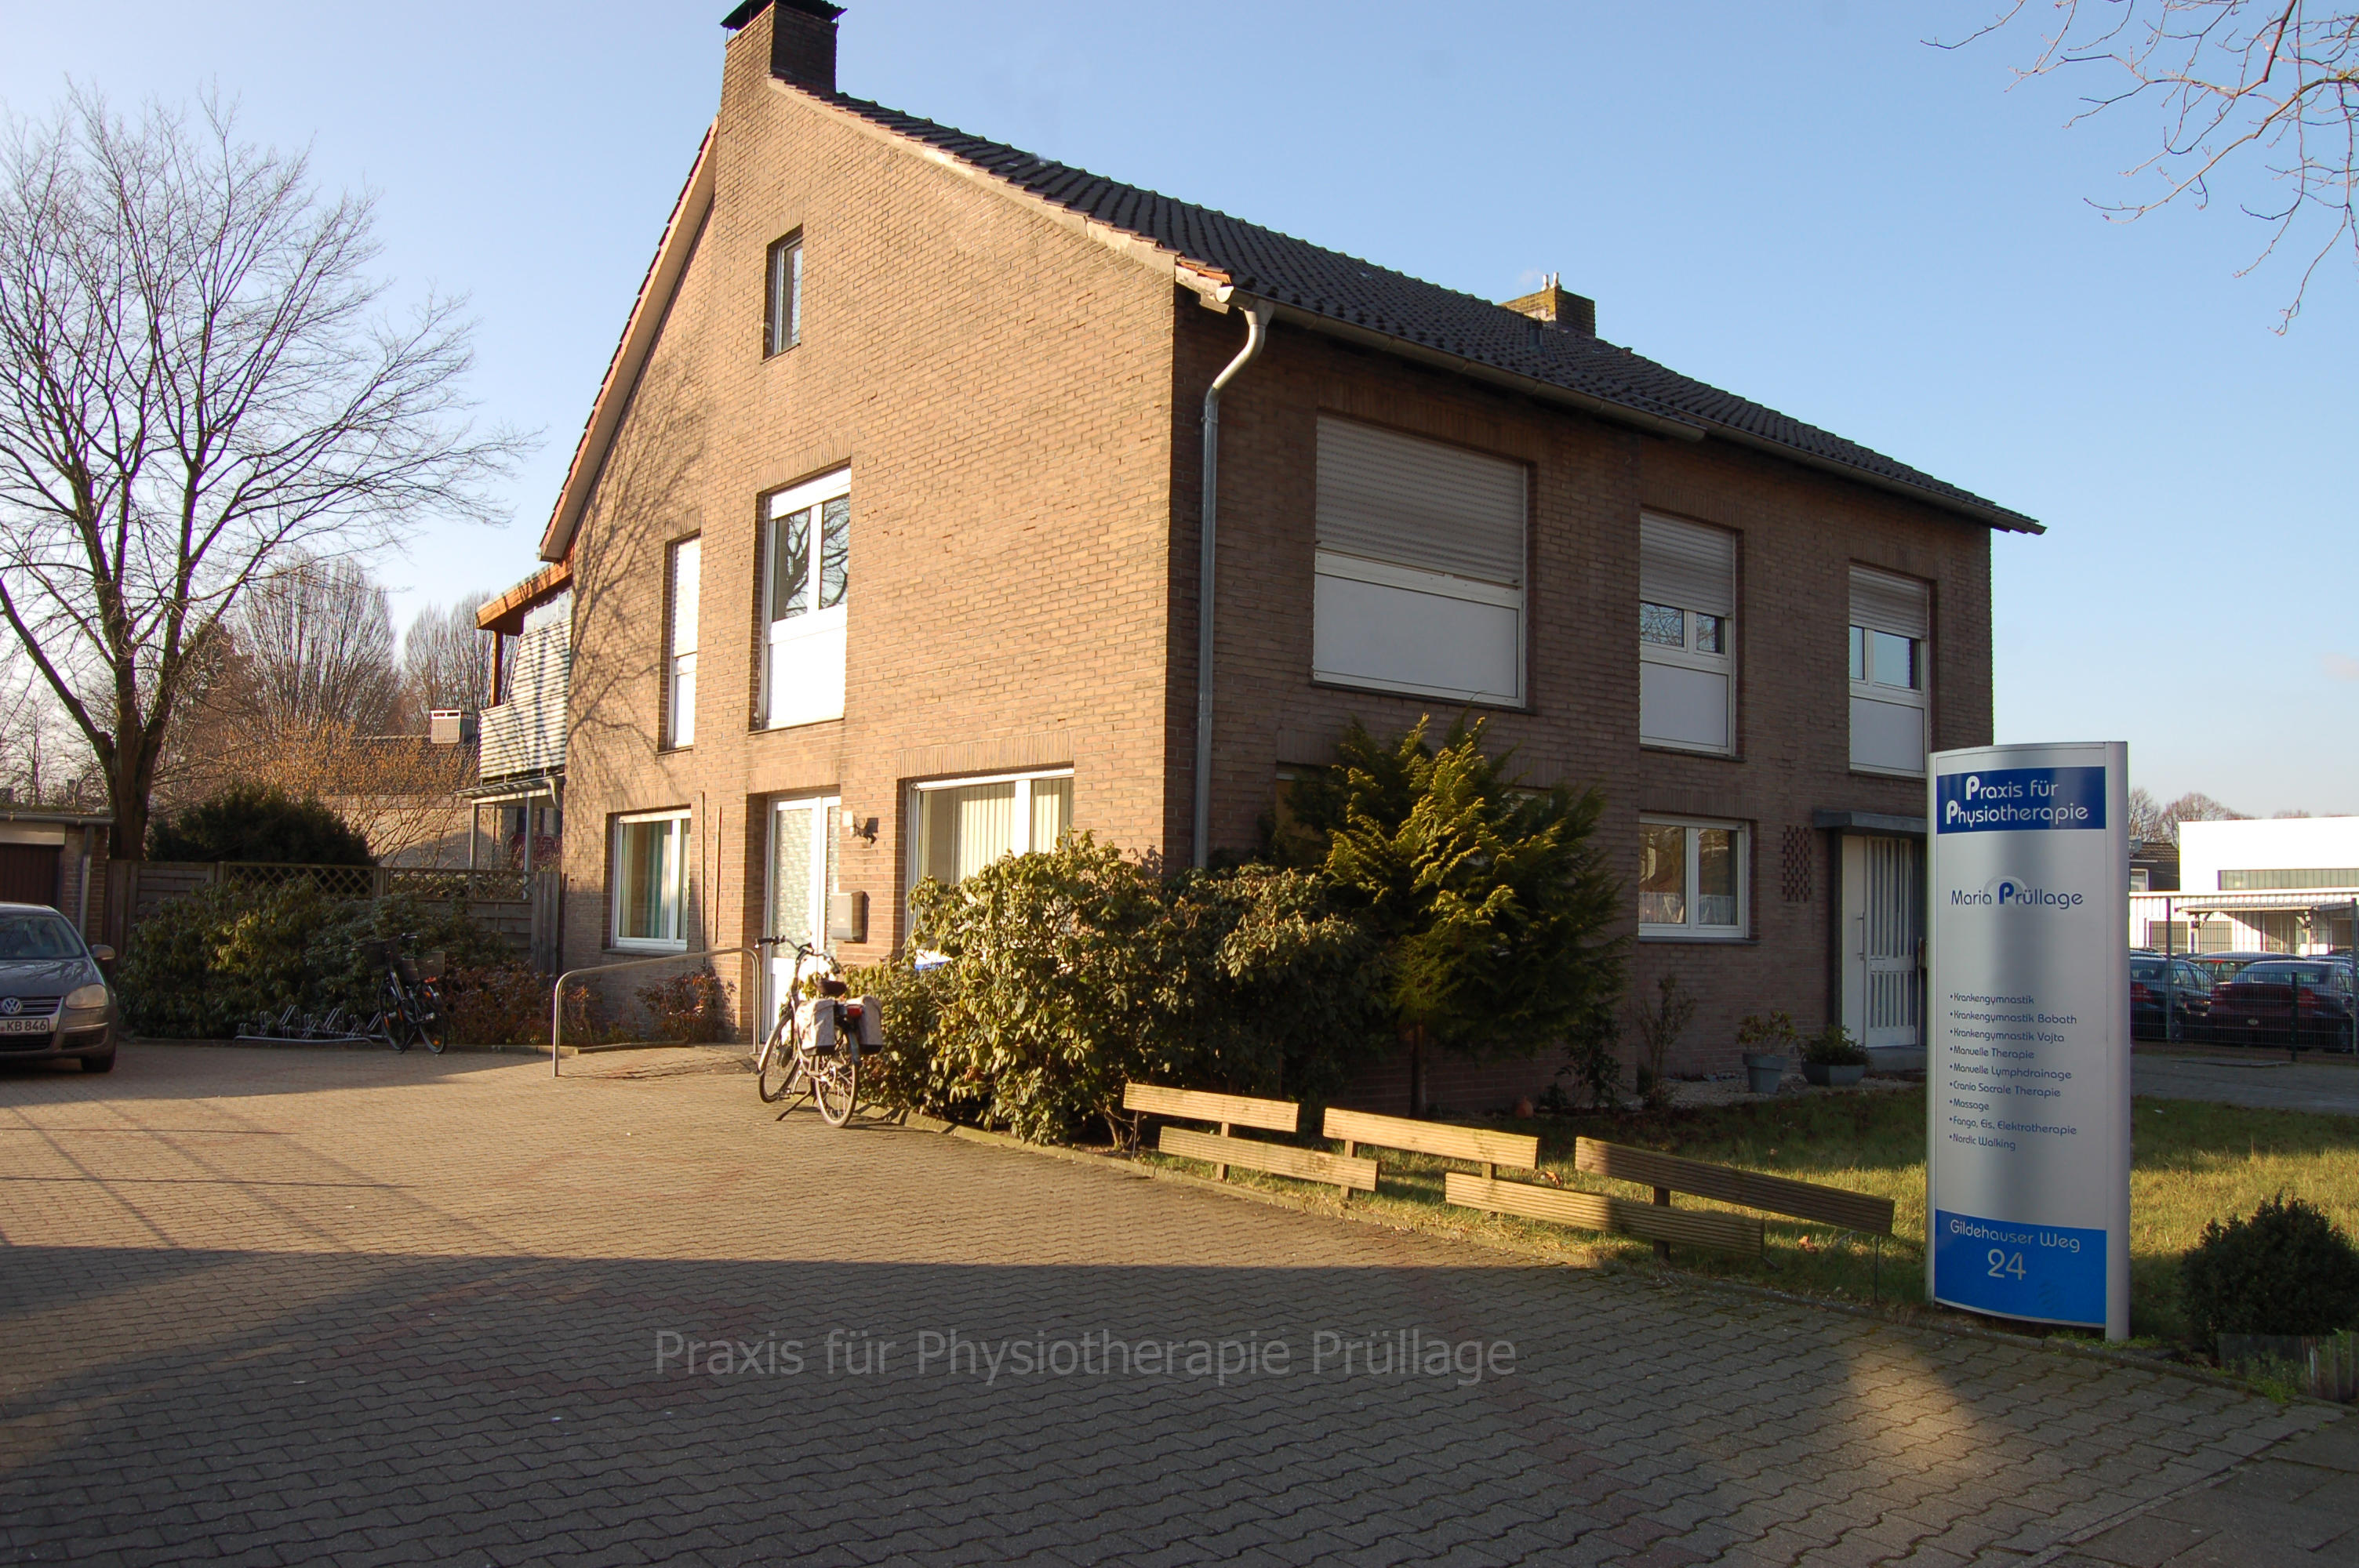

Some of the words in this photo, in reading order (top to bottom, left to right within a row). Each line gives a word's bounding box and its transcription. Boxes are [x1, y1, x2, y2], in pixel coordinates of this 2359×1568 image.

[1965, 775, 2023, 800] Praxis
[2030, 779, 2059, 797] für
[1946, 800, 2088, 828] Physiotherapie
[1950, 889, 1993, 906] Maria
[1998, 881, 2084, 909] Prüllage
[1953, 993, 2034, 1006] Krankengymnastik
[1953, 1010, 2034, 1023] Krankengymnastik
[6, 1021, 23, 1032] KB
[24, 1021, 47, 1032] 846
[1953, 1028, 2034, 1041] Krankengymnastik
[2037, 1031, 2065, 1044] Vojta
[1953, 1045, 1989, 1058] Manuelle
[1991, 1047, 2035, 1061] Therapie
[1953, 1062, 1989, 1075] Manuelle
[1991, 1065, 2072, 1081] Lymphdrainage
[1953, 1080, 1976, 1091] Cranio
[1978, 1083, 2012, 1094] Sacrale
[2014, 1085, 2061, 1099] Therapie
[1953, 1098, 1990, 1112] Massage
[1953, 1116, 1978, 1129] Fango,
[1997, 1120, 2077, 1136] Elektrotherapie
[1953, 1133, 1976, 1145] Nordic
[1978, 1136, 2016, 1152] Walking
[1950, 1218, 2034, 1245] Gildehauser
[2039, 1232, 2081, 1253] Weg
[1986, 1248, 2026, 1281] 24
